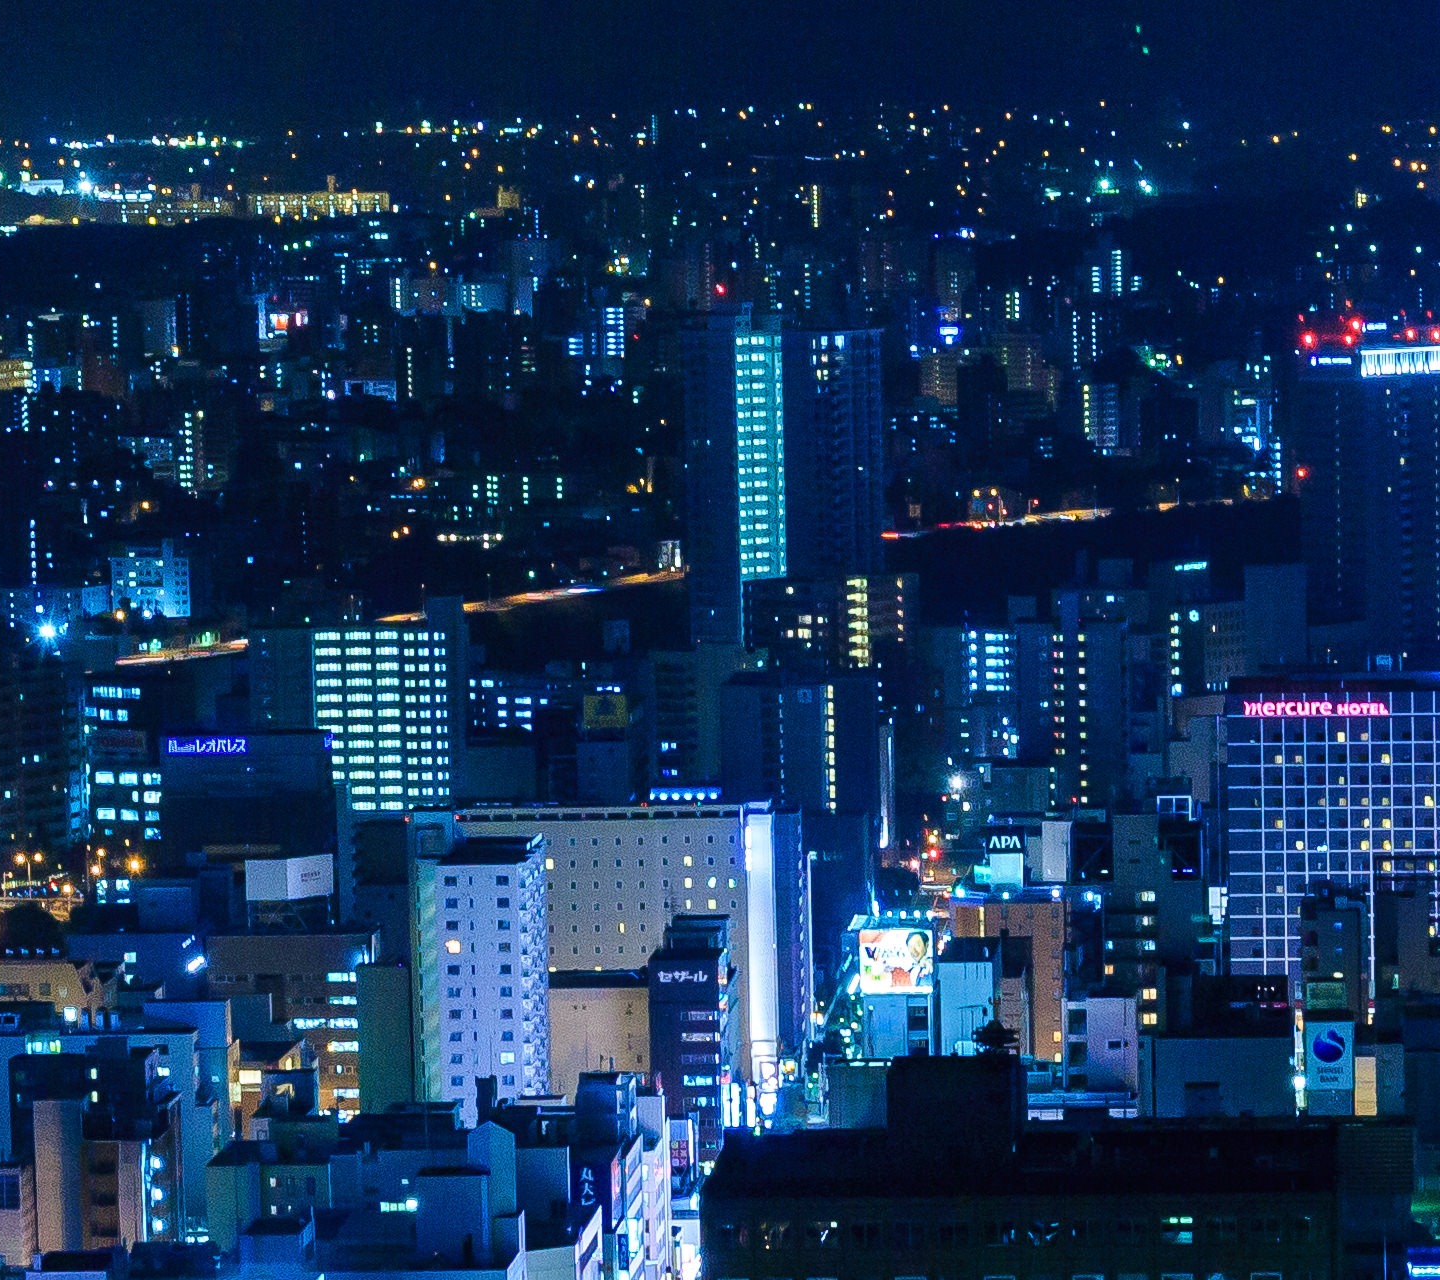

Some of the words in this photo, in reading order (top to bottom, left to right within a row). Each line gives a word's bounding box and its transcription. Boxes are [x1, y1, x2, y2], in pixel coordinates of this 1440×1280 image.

[1243, 701, 1333, 717] mercure
[1336, 702, 1389, 716] HOTEL
[989, 835, 1021, 848] APA
[658, 970, 708, 983] セザール
